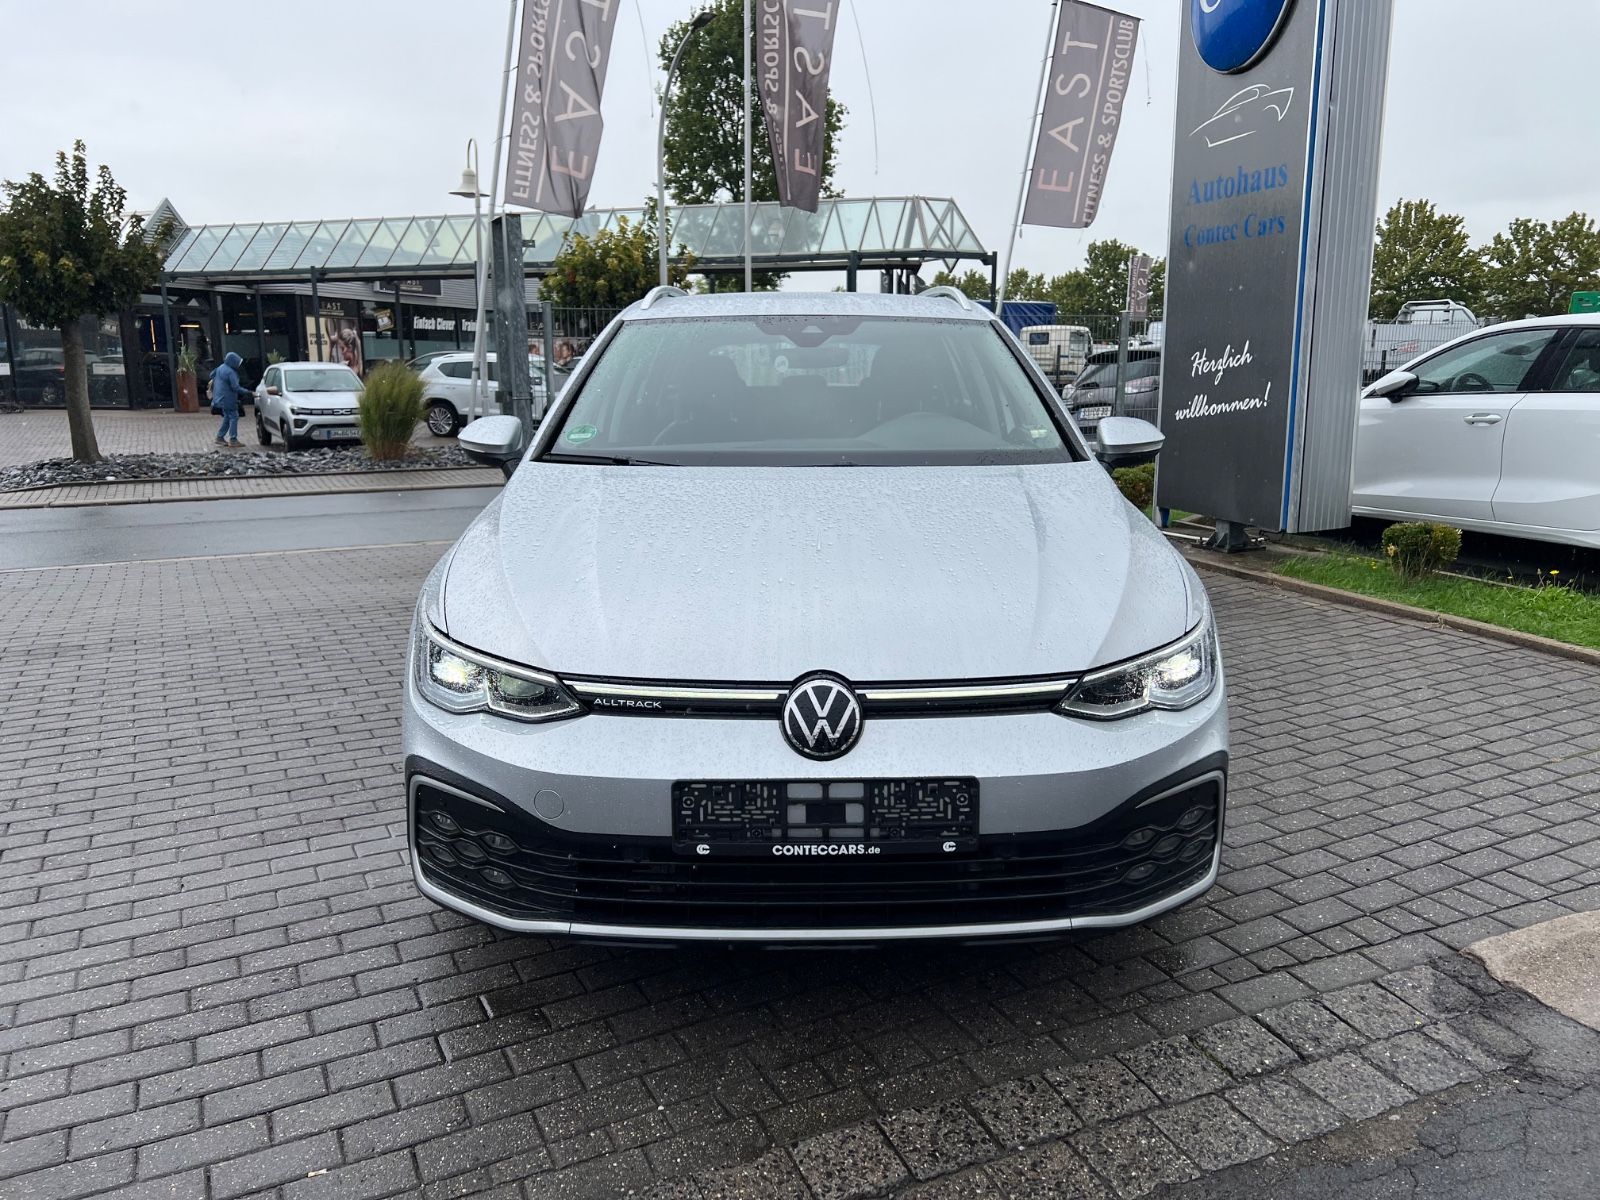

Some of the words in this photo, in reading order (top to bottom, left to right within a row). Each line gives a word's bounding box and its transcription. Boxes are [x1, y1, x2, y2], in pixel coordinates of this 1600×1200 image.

[1102, 19, 1134, 126] SPORTSCLUB
[1037, 32, 1098, 192] EAST
[1098, 133, 1113, 148] &
[1083, 153, 1106, 223] FITNESS
[1188, 163, 1288, 205] Autohaus
[1184, 223, 1238, 248] Contec
[1243, 213, 1286, 238] Cars
[1191, 340, 1253, 385] Herzlich
[1175, 381, 1271, 421] willkommen!
[593, 698, 662, 709] ALLTRACK
[772, 844, 881, 856] CONTECCARS.de
